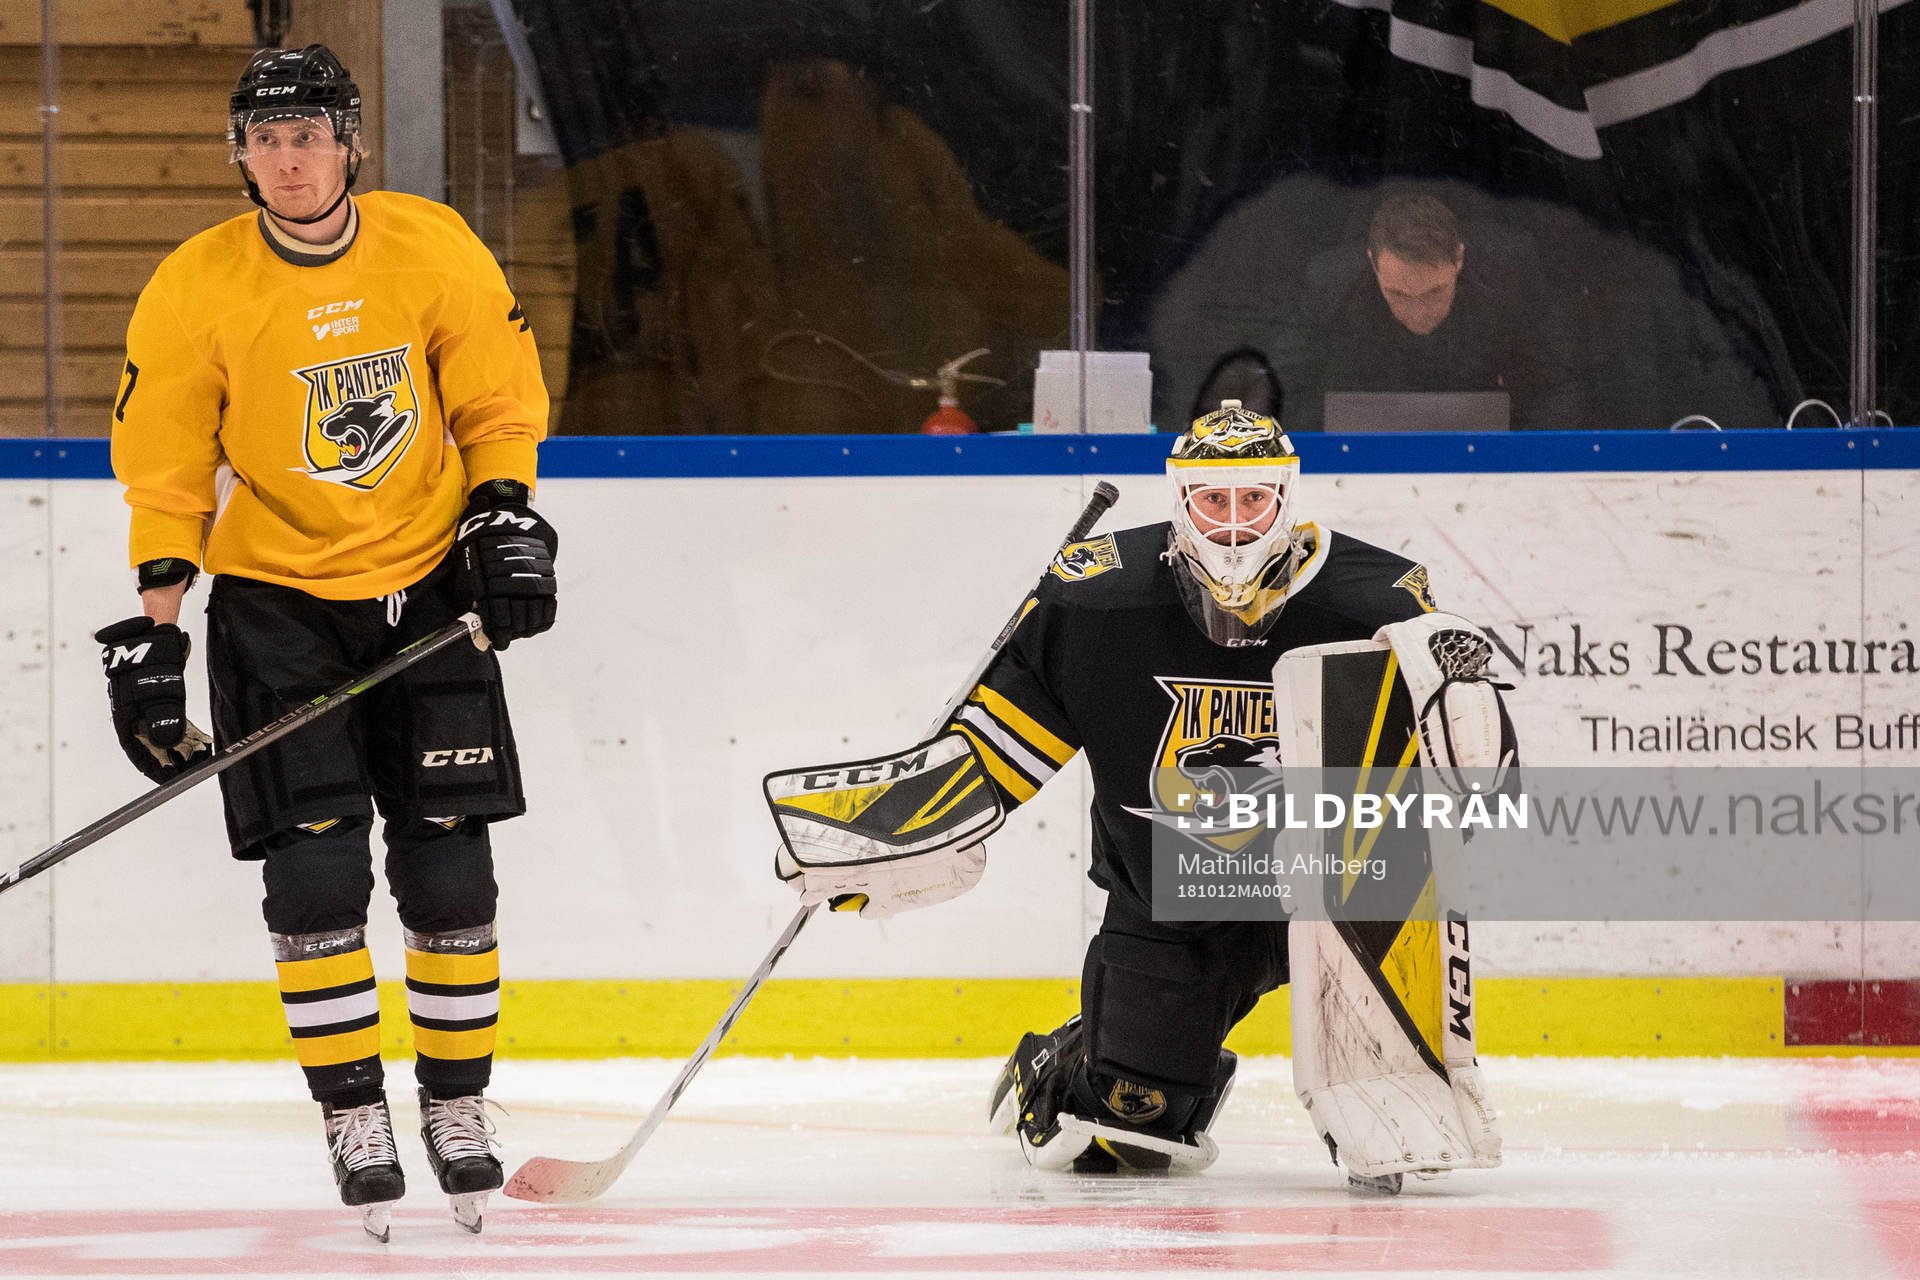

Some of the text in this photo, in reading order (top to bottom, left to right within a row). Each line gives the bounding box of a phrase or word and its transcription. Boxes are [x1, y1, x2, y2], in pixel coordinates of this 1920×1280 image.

[255, 85, 297, 97] CCM
[307, 299, 365, 320] CCM
[331, 316, 359, 329] INTER
[332, 325, 360, 337] SPORT
[313, 354, 402, 412] IK PANTERN
[1226, 638, 1268, 648] CCM
[1477, 623, 1631, 678] Naks
[1182, 687, 1278, 739] IK PANTE
[1581, 715, 1818, 752] Thailändsk
[802, 750, 930, 791] CCM
[1532, 780, 1920, 836] www.naksr
[306, 938, 346, 952] CCM
[440, 939, 481, 948] CCM
[1446, 908, 1472, 1042] CCM
